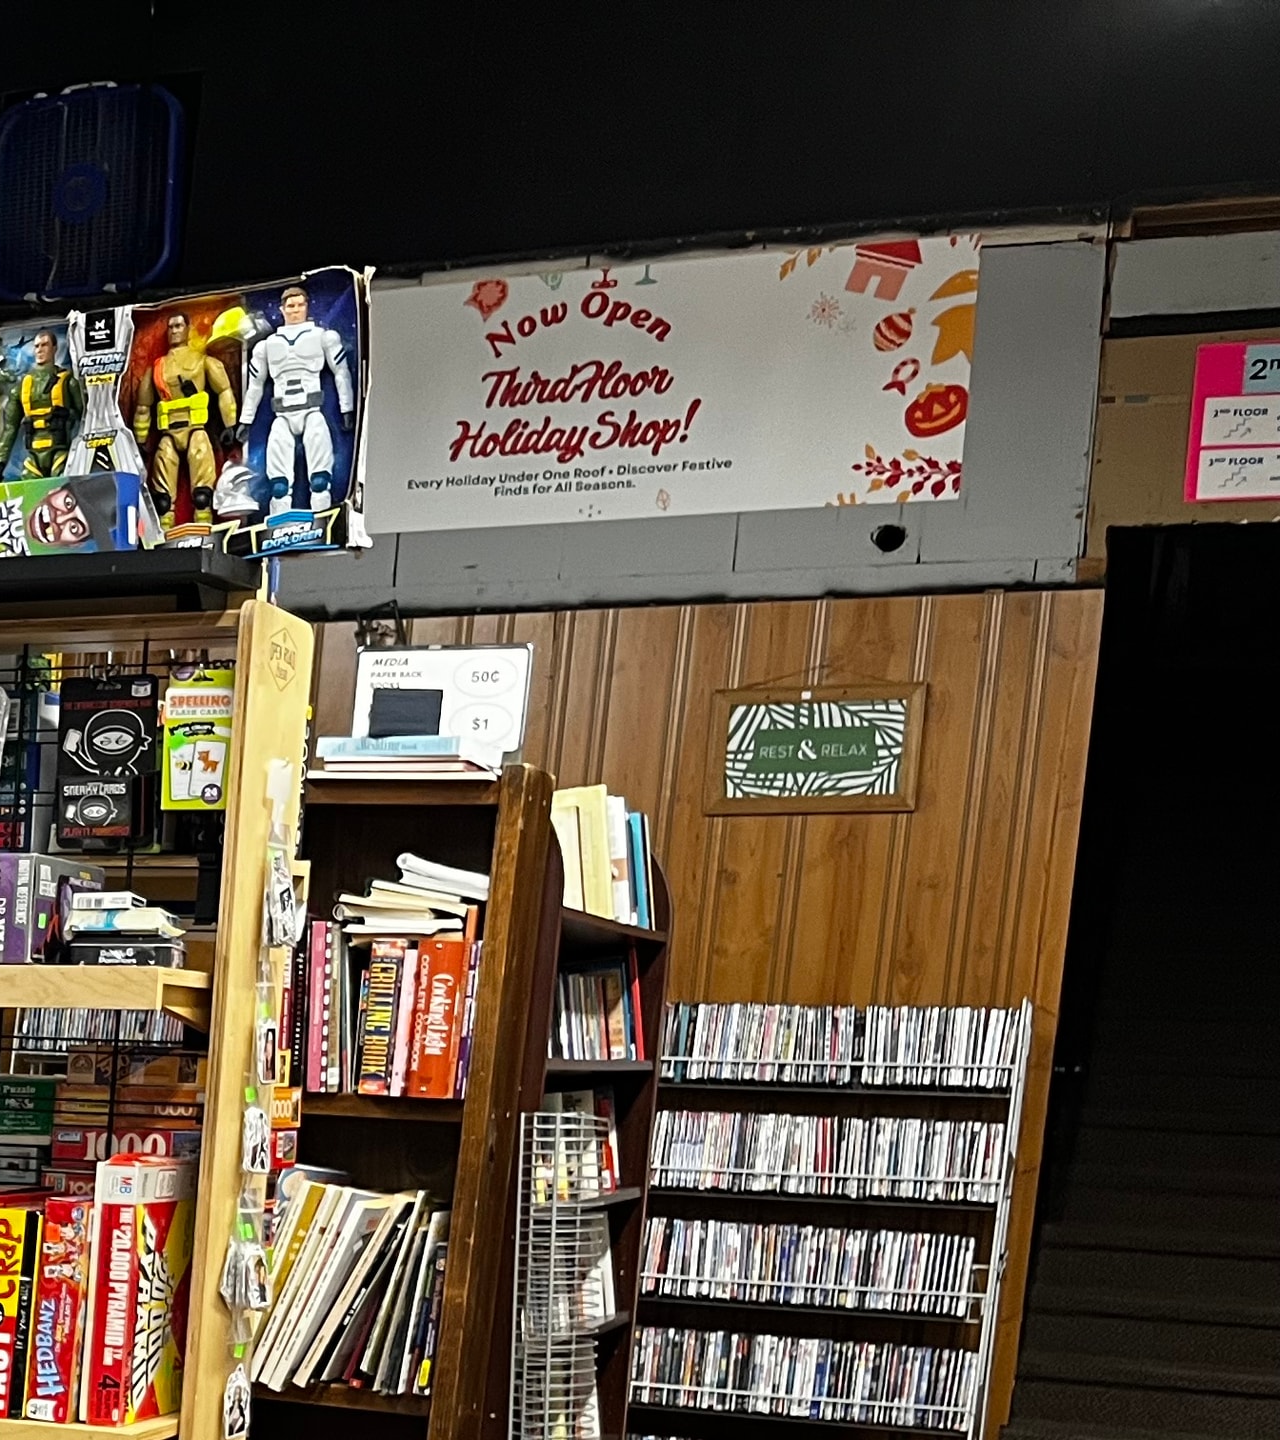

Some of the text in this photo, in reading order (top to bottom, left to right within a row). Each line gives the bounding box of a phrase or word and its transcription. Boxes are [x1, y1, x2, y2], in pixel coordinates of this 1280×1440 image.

[485, 291, 672, 358] Now Open
[1249, 358, 1280, 381] 2n
[482, 360, 674, 408] Third Floor
[1233, 407, 1269, 417] FLOOR
[450, 398, 702, 463] Holiday Shop!
[1228, 456, 1264, 466] FLOOR
[407, 457, 732, 490] Every Holiday Under One Roof Discover Festive
[494, 478, 636, 497] Finds for All Seasons.
[6, 495, 32, 557] MUS
[272, 521, 312, 539] SPACE
[261, 528, 324, 550] EXPLORER
[372, 657, 410, 667] MEDIA
[400, 671, 423, 679] BACK
[169, 694, 232, 708] SPELLING
[471, 718, 489, 731] $1
[759, 738, 868, 761] REST & RELAX
[204, 787, 218, 797] 24
[361, 962, 398, 1077] GRILLING BOOK
[410, 954, 430, 1072] COMPLETE COOKBOOK
[2, 1085, 37, 1094] Puzzle
[83, 1131, 167, 1161] 1000
[119, 1176, 133, 1194] MB
[119, 1207, 133, 1224] THE
[104, 1281, 129, 1346] PYRAMID
[132, 1213, 158, 1414] PYRAMID
[35, 1298, 67, 1397] HEDBANZ
[97, 1374, 122, 1392] 4
